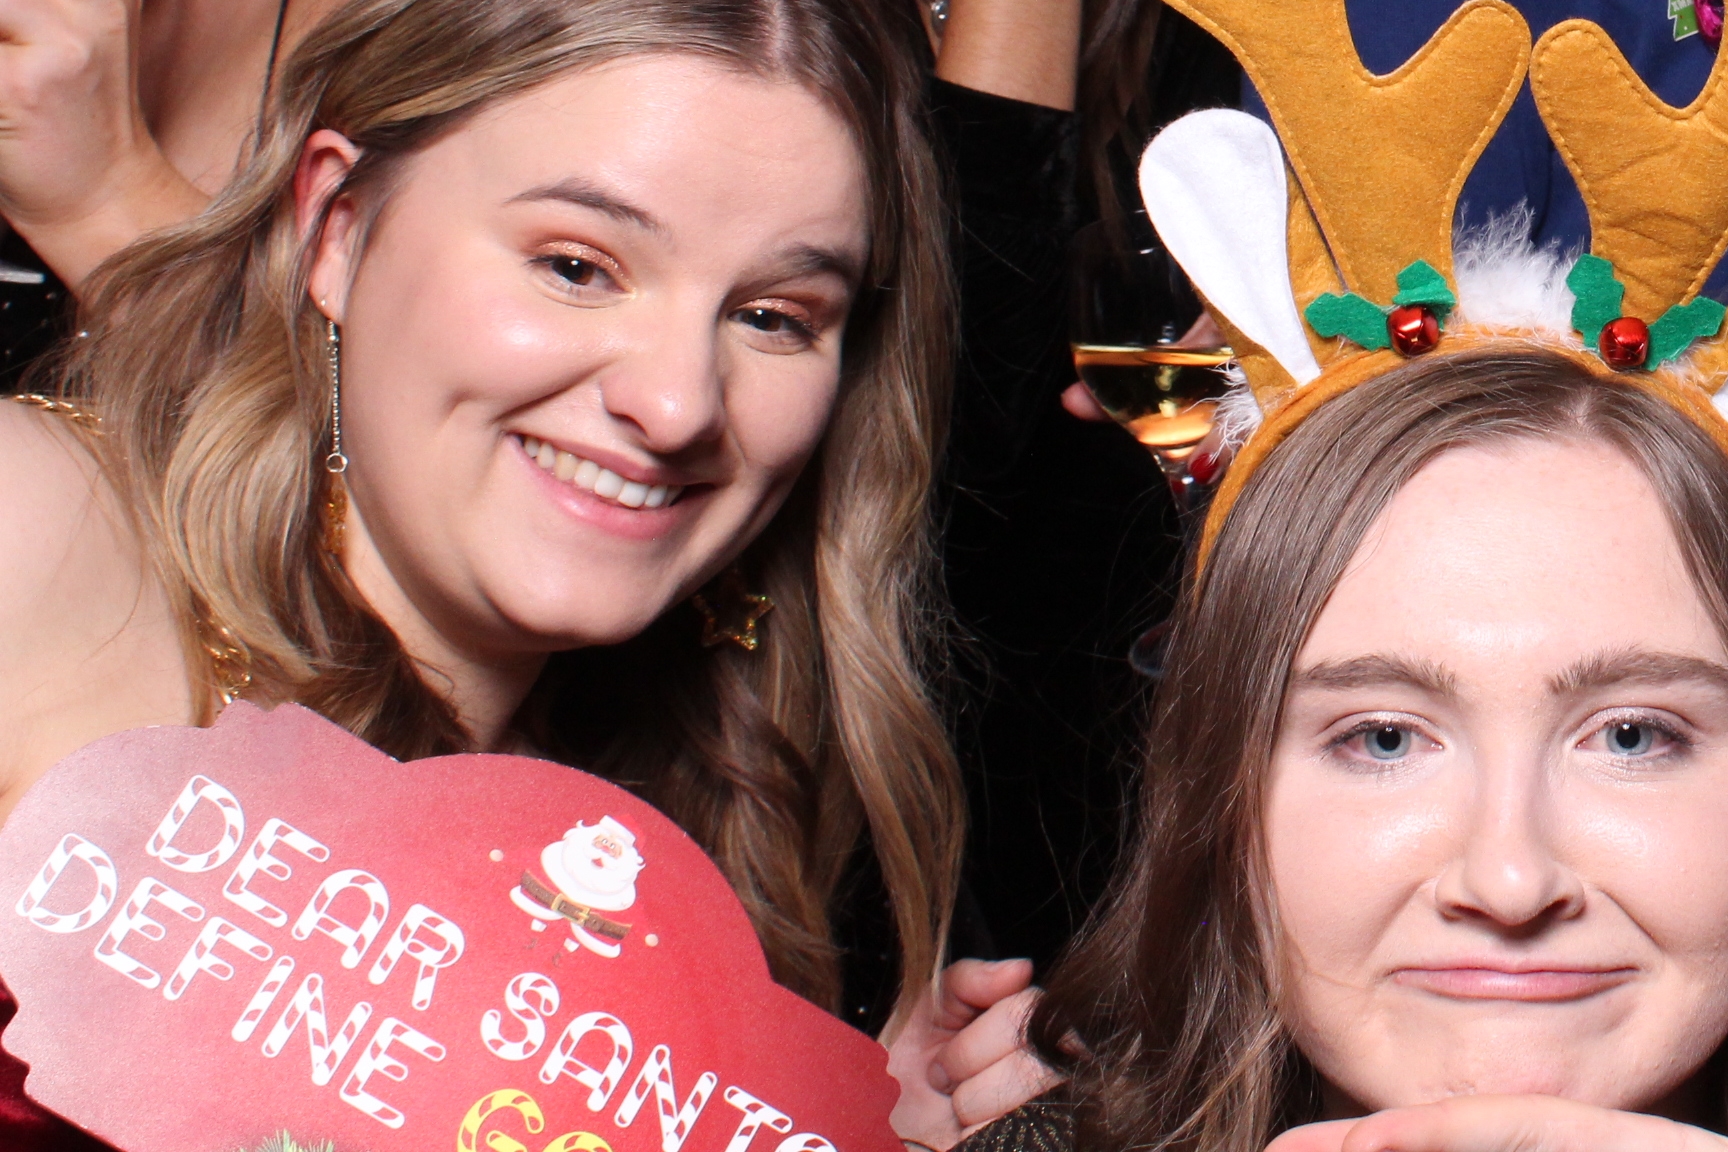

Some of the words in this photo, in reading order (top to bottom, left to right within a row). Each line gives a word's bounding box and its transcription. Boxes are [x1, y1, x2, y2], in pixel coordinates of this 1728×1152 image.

[14, 832, 447, 1129] DEFINE
[145, 774, 466, 1011] DEAR
[480, 972, 840, 1152] SANT
